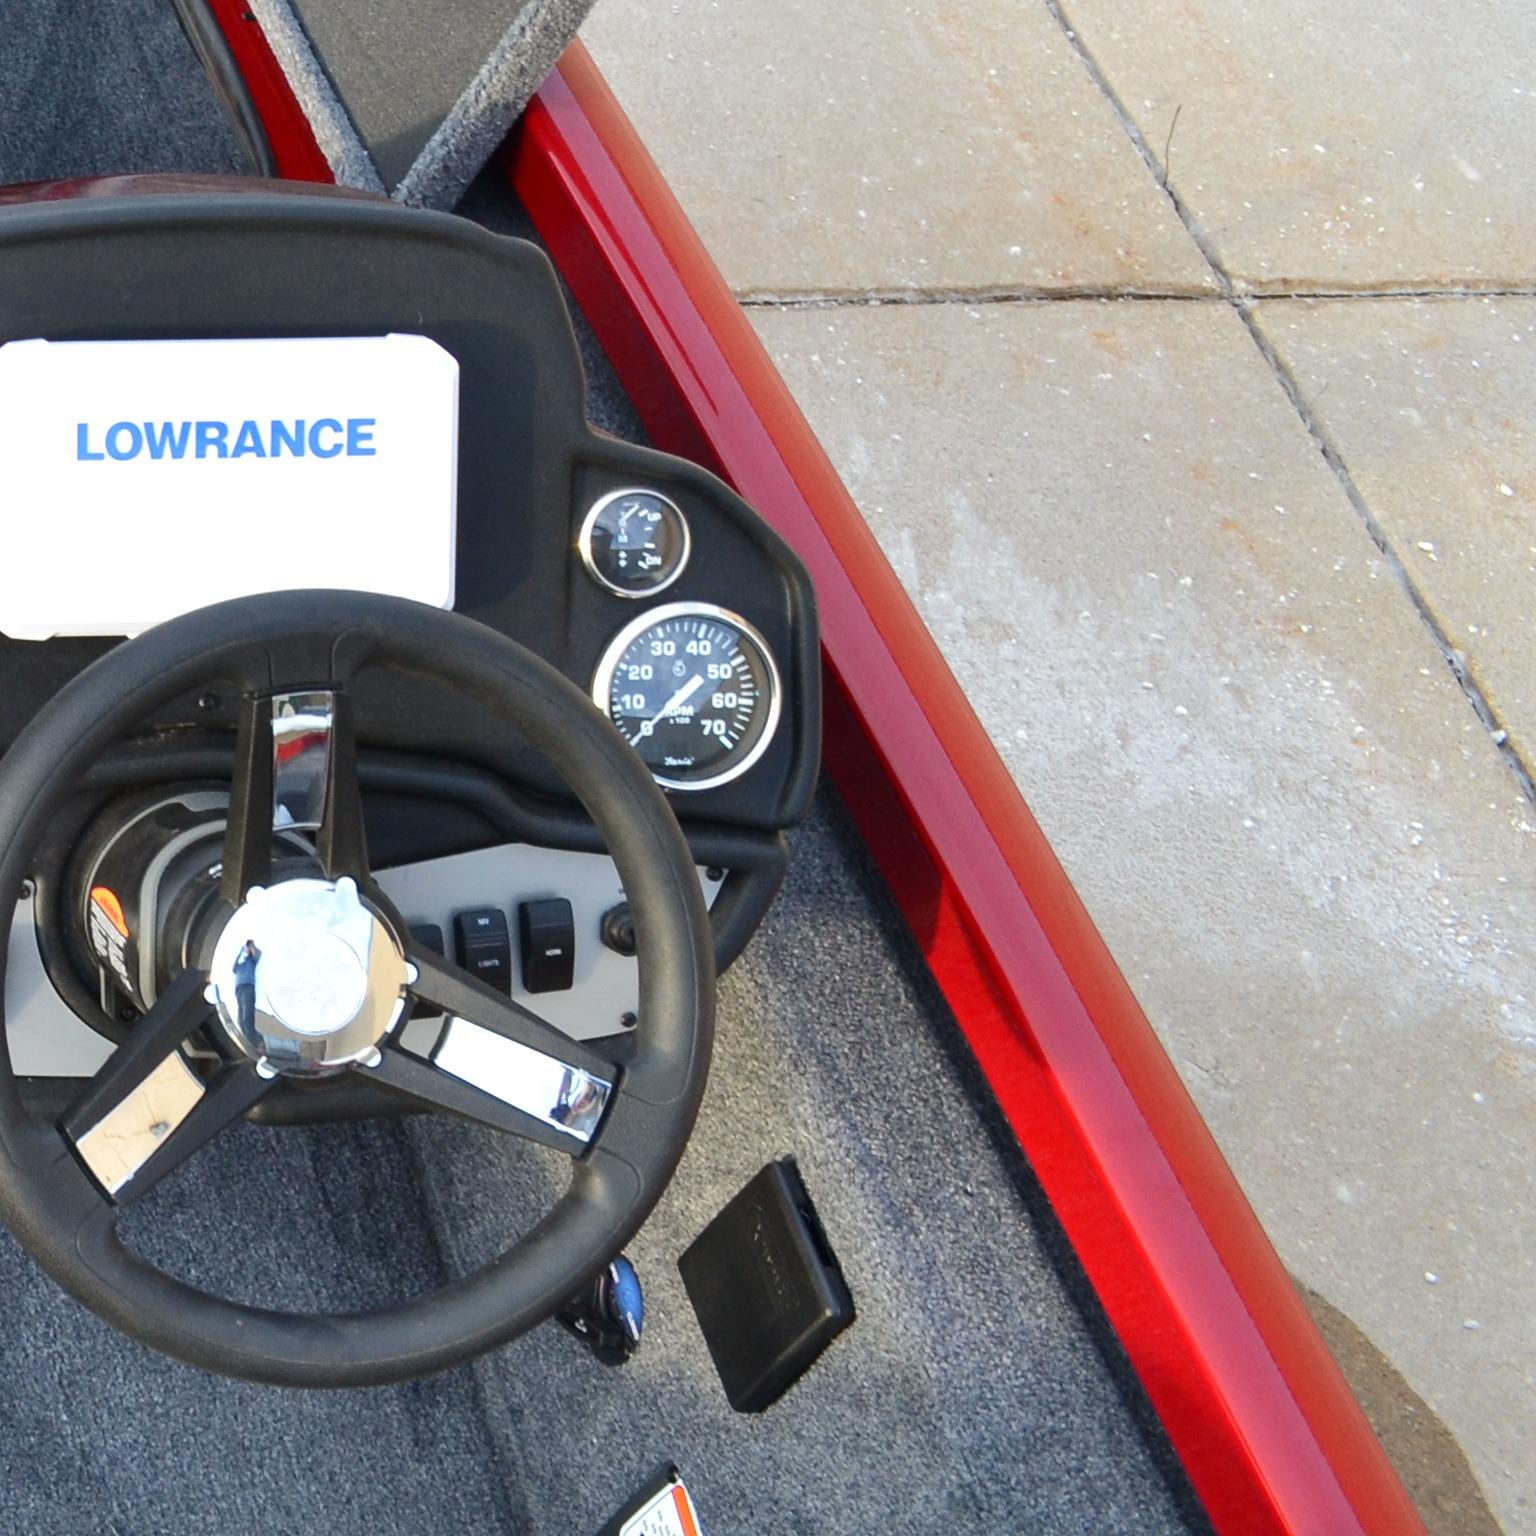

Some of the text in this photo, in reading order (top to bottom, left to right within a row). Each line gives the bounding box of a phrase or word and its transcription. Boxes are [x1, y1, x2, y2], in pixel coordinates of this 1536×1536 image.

[77, 418, 377, 461] LOWRANCE
[648, 512, 662, 522] UP
[650, 640, 676, 656] 30
[685, 640, 712, 656] 40
[628, 664, 654, 681] 20
[706, 664, 733, 680] 50
[621, 694, 646, 710] 10
[711, 693, 738, 709] 60
[700, 719, 726, 735] 70
